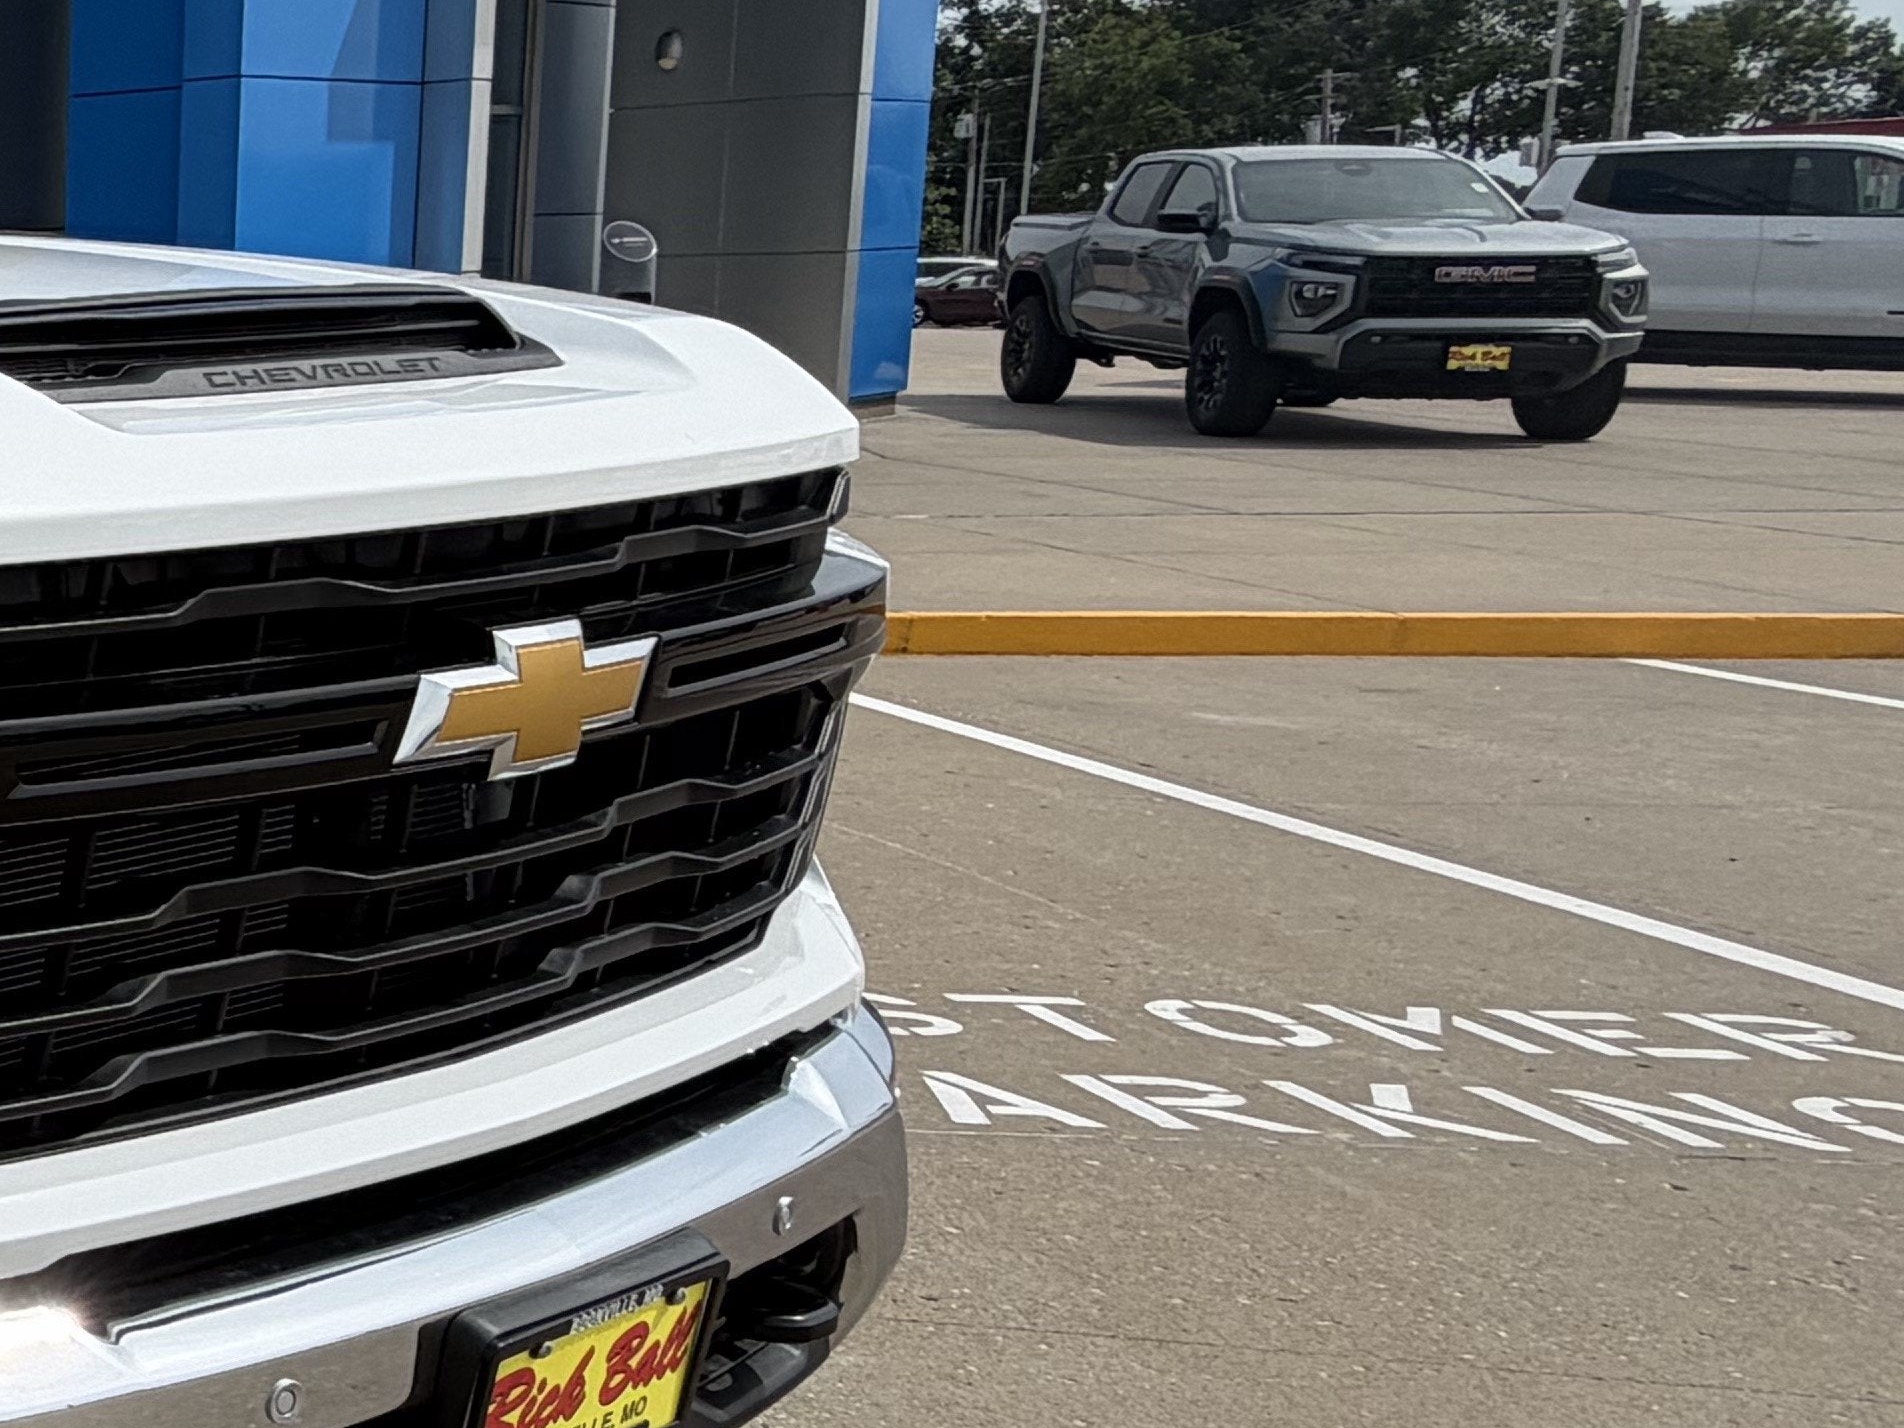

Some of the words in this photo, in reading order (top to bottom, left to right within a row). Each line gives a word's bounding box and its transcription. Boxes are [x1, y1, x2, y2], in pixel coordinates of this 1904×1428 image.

[1434, 265, 1537, 283] GMC
[202, 356, 441, 389] CHEVROLET
[598, 1294, 703, 1407] Ball
[619, 1395, 649, 1425] MO
